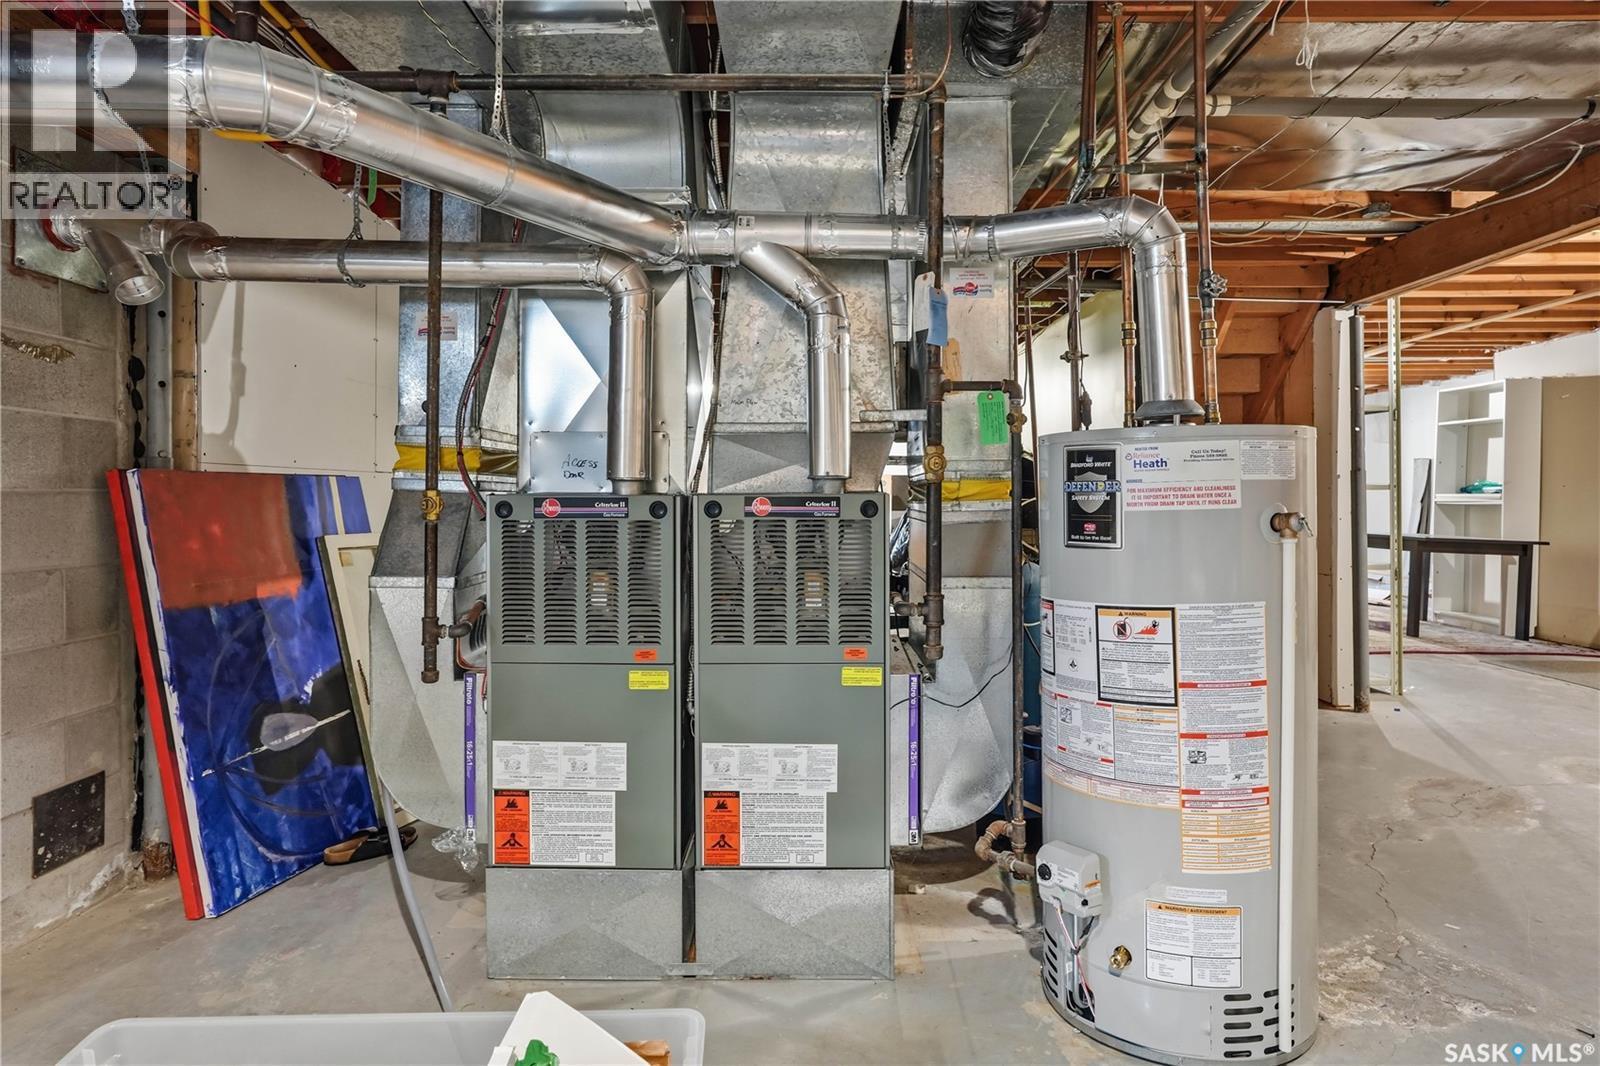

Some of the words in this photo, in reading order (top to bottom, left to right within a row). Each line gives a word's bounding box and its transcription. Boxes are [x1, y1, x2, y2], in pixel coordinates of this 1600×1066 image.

[1133, 458, 1168, 468] Heath
[1064, 481, 1120, 492] DEFENDER
[911, 832, 917, 842] 3M
